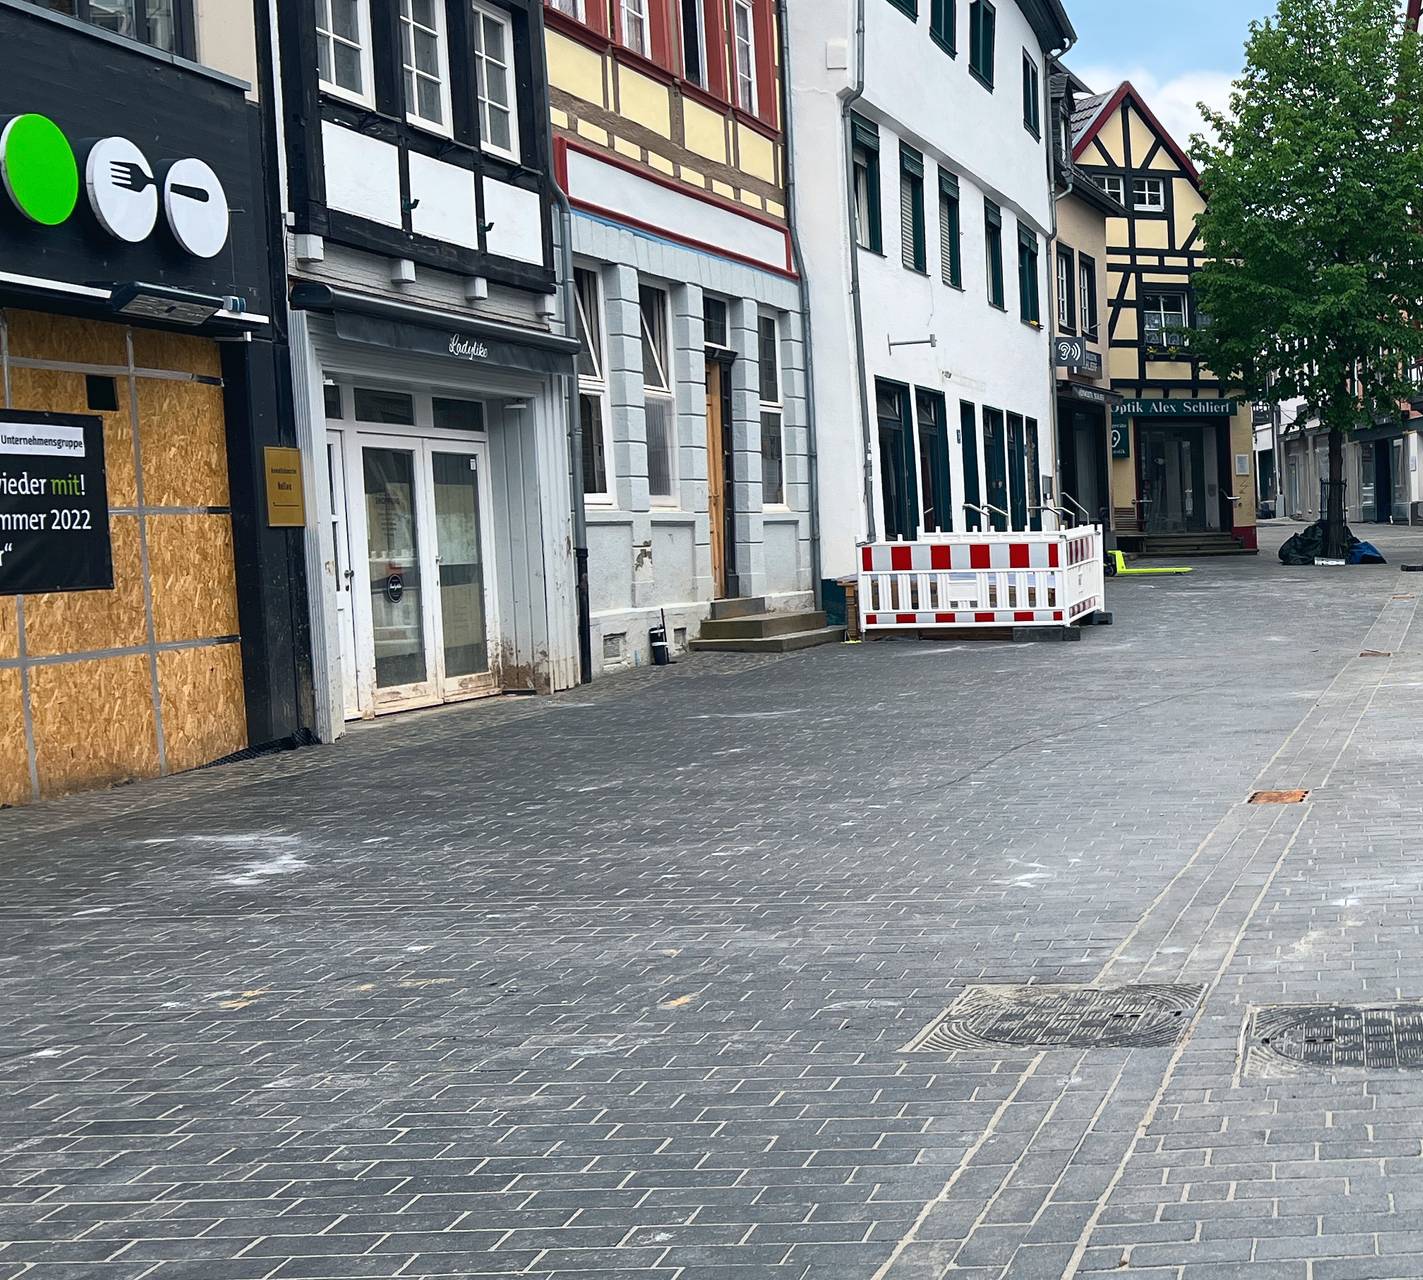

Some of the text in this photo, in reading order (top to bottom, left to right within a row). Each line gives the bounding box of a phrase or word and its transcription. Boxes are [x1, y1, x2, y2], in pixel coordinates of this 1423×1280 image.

[449, 334, 488, 360] Ladylike
[1150, 402, 1177, 413] Alex
[1, 435, 83, 449] Unternehmensgruppe
[0, 472, 86, 496] ieder mit!
[51, 509, 92, 530] 2022
